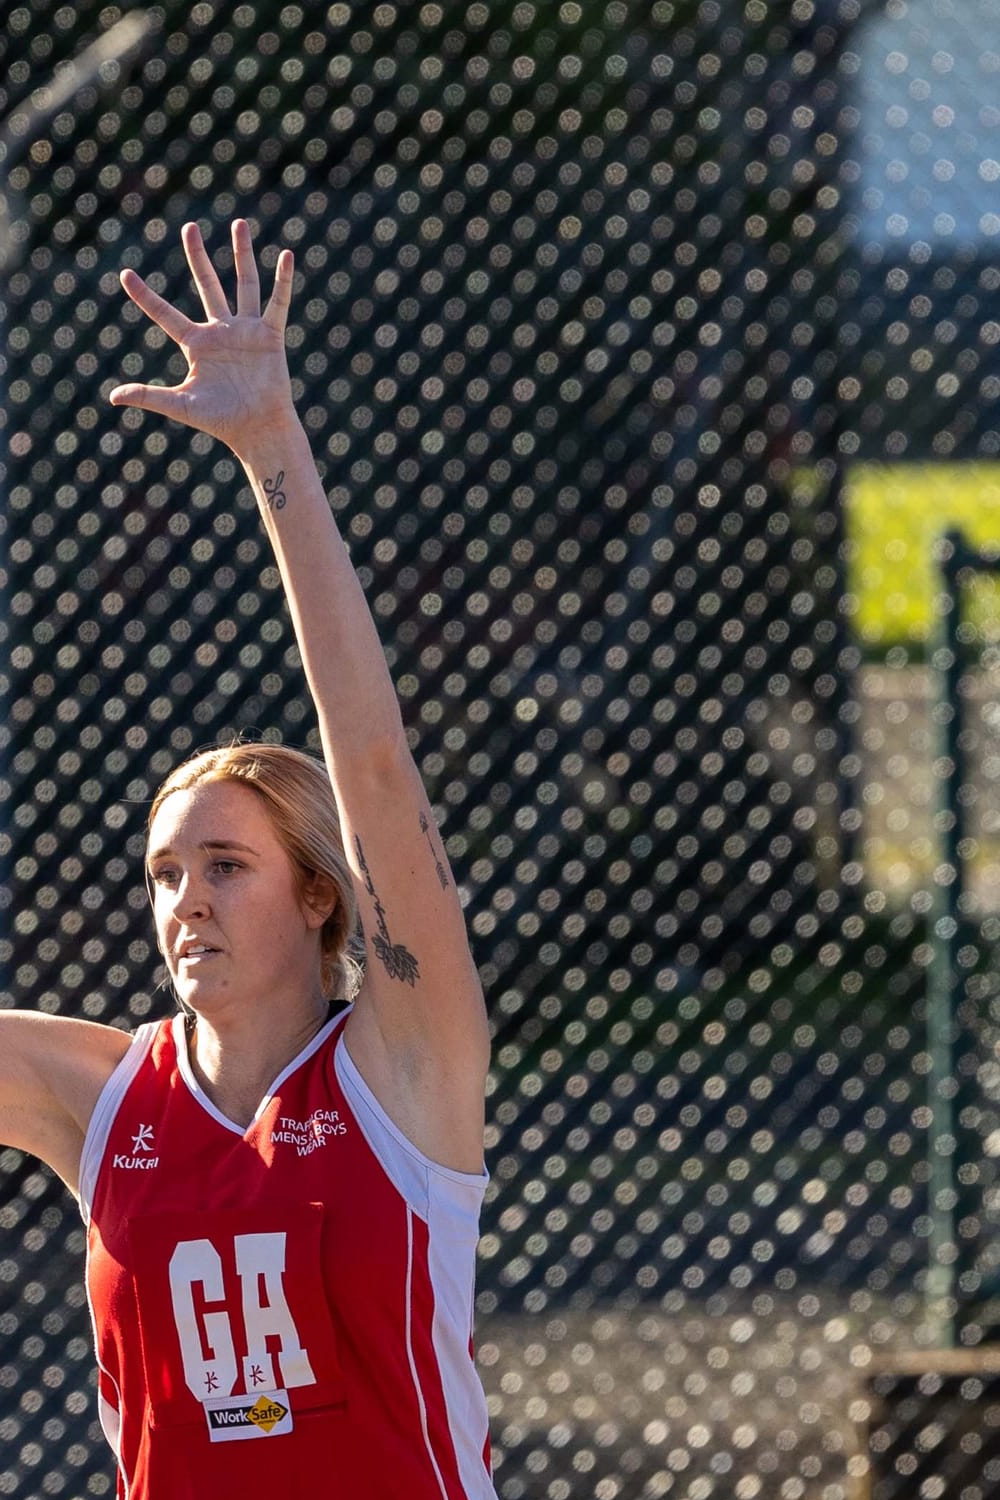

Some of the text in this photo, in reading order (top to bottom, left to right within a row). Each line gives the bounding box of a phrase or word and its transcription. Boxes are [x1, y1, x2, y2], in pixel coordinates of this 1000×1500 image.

[280, 1109, 340, 1133] TRAFGAR
[271, 1131, 308, 1146] MENS
[314, 1122, 348, 1138] BOYS
[296, 1135, 327, 1157] WEAR
[112, 1154, 160, 1170] KUKRI
[168, 1232, 317, 1402] GA
[214, 1405, 281, 1425] WorkSafe
